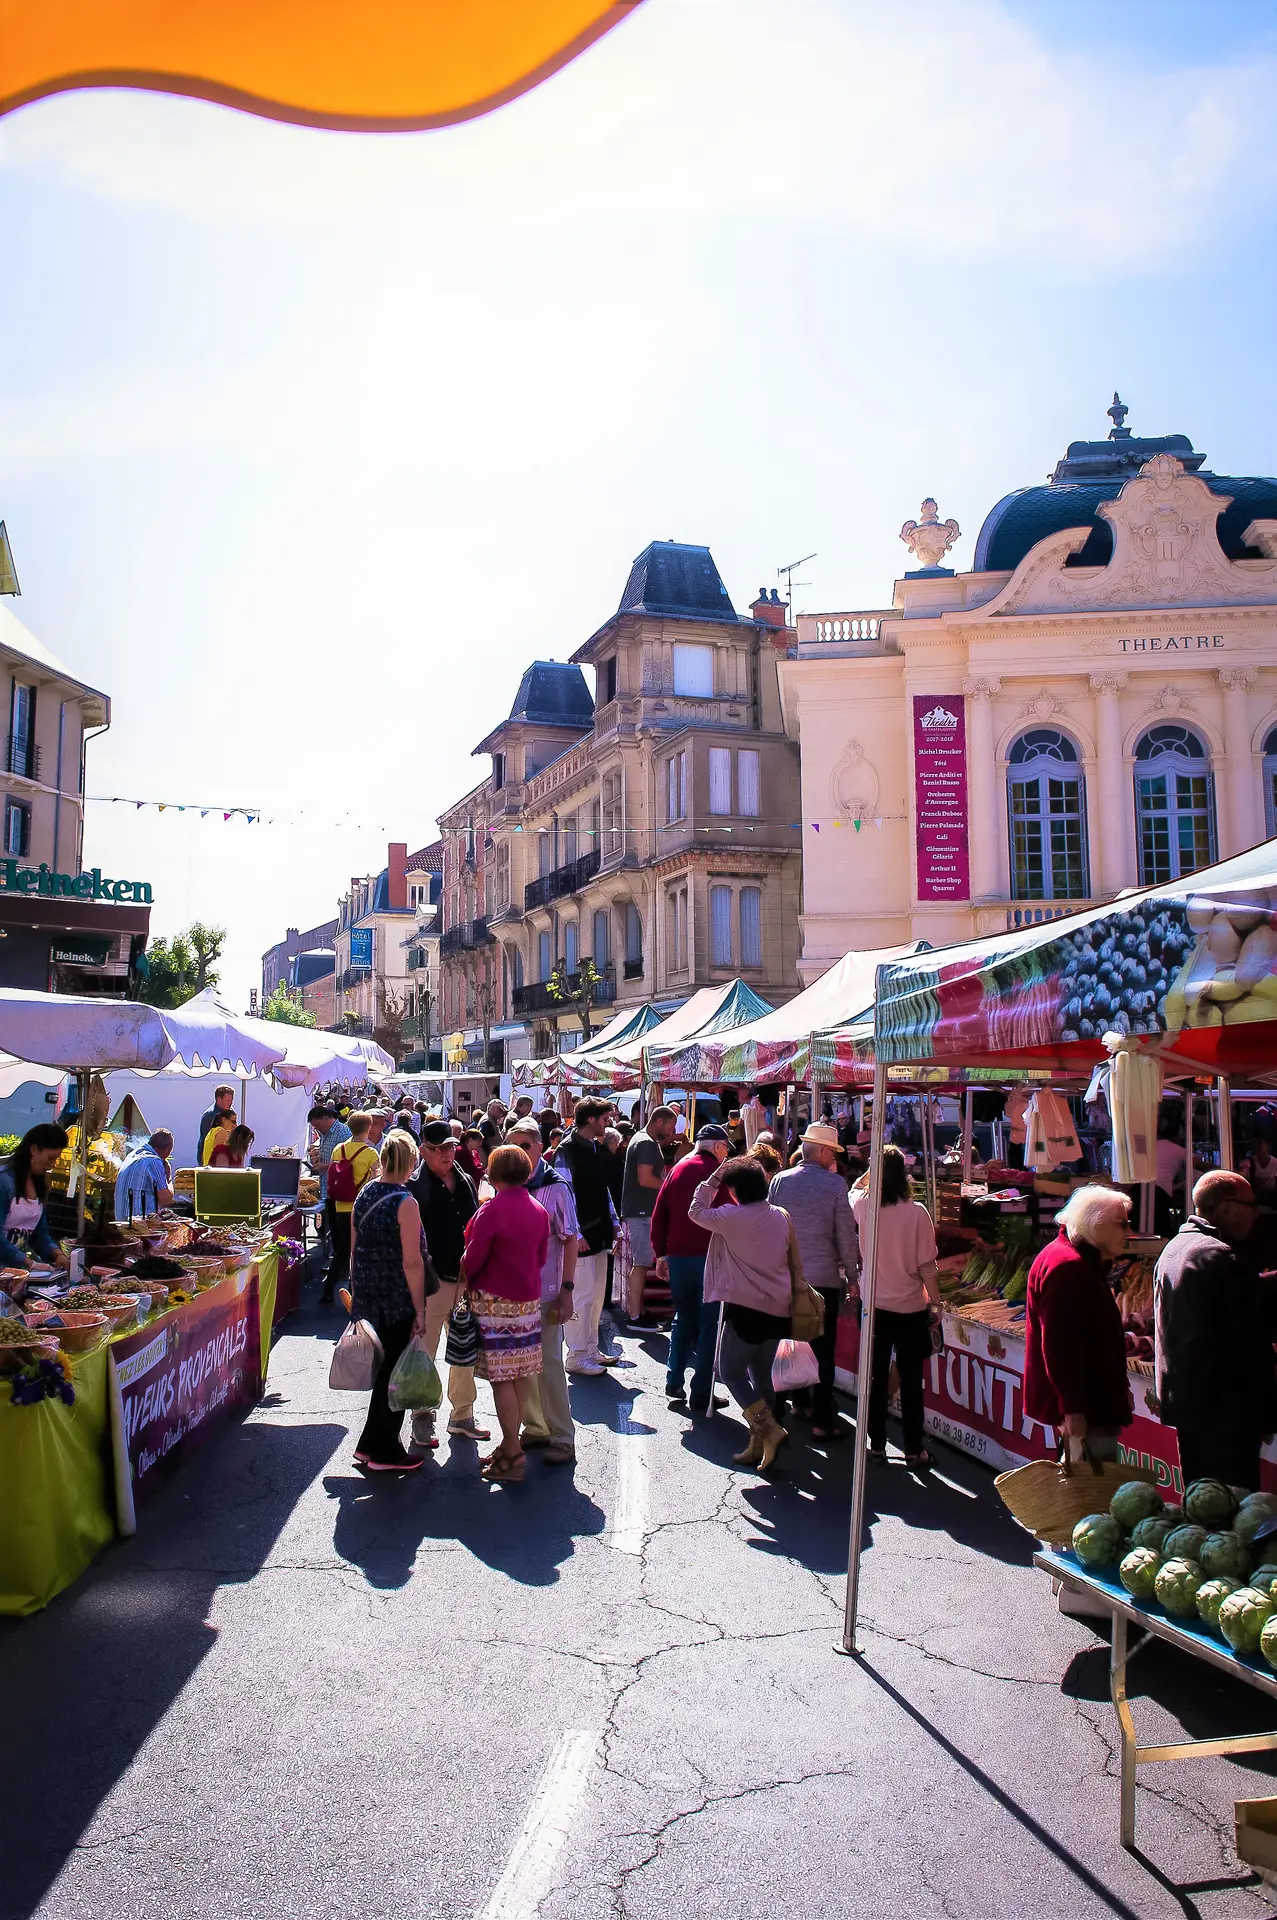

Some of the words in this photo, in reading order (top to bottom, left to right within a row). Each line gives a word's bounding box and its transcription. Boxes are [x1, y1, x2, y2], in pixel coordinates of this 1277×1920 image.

[1117, 635, 1225, 651] THEATRE
[0, 858, 155, 904] Heineken
[124, 1368, 175, 1449] AVEURS
[177, 1317, 248, 1405] PROVENÇALES
[964, 1432, 976, 1448] 88
[977, 1439, 987, 1454] 51
[1117, 1442, 1182, 1494] MIDI
